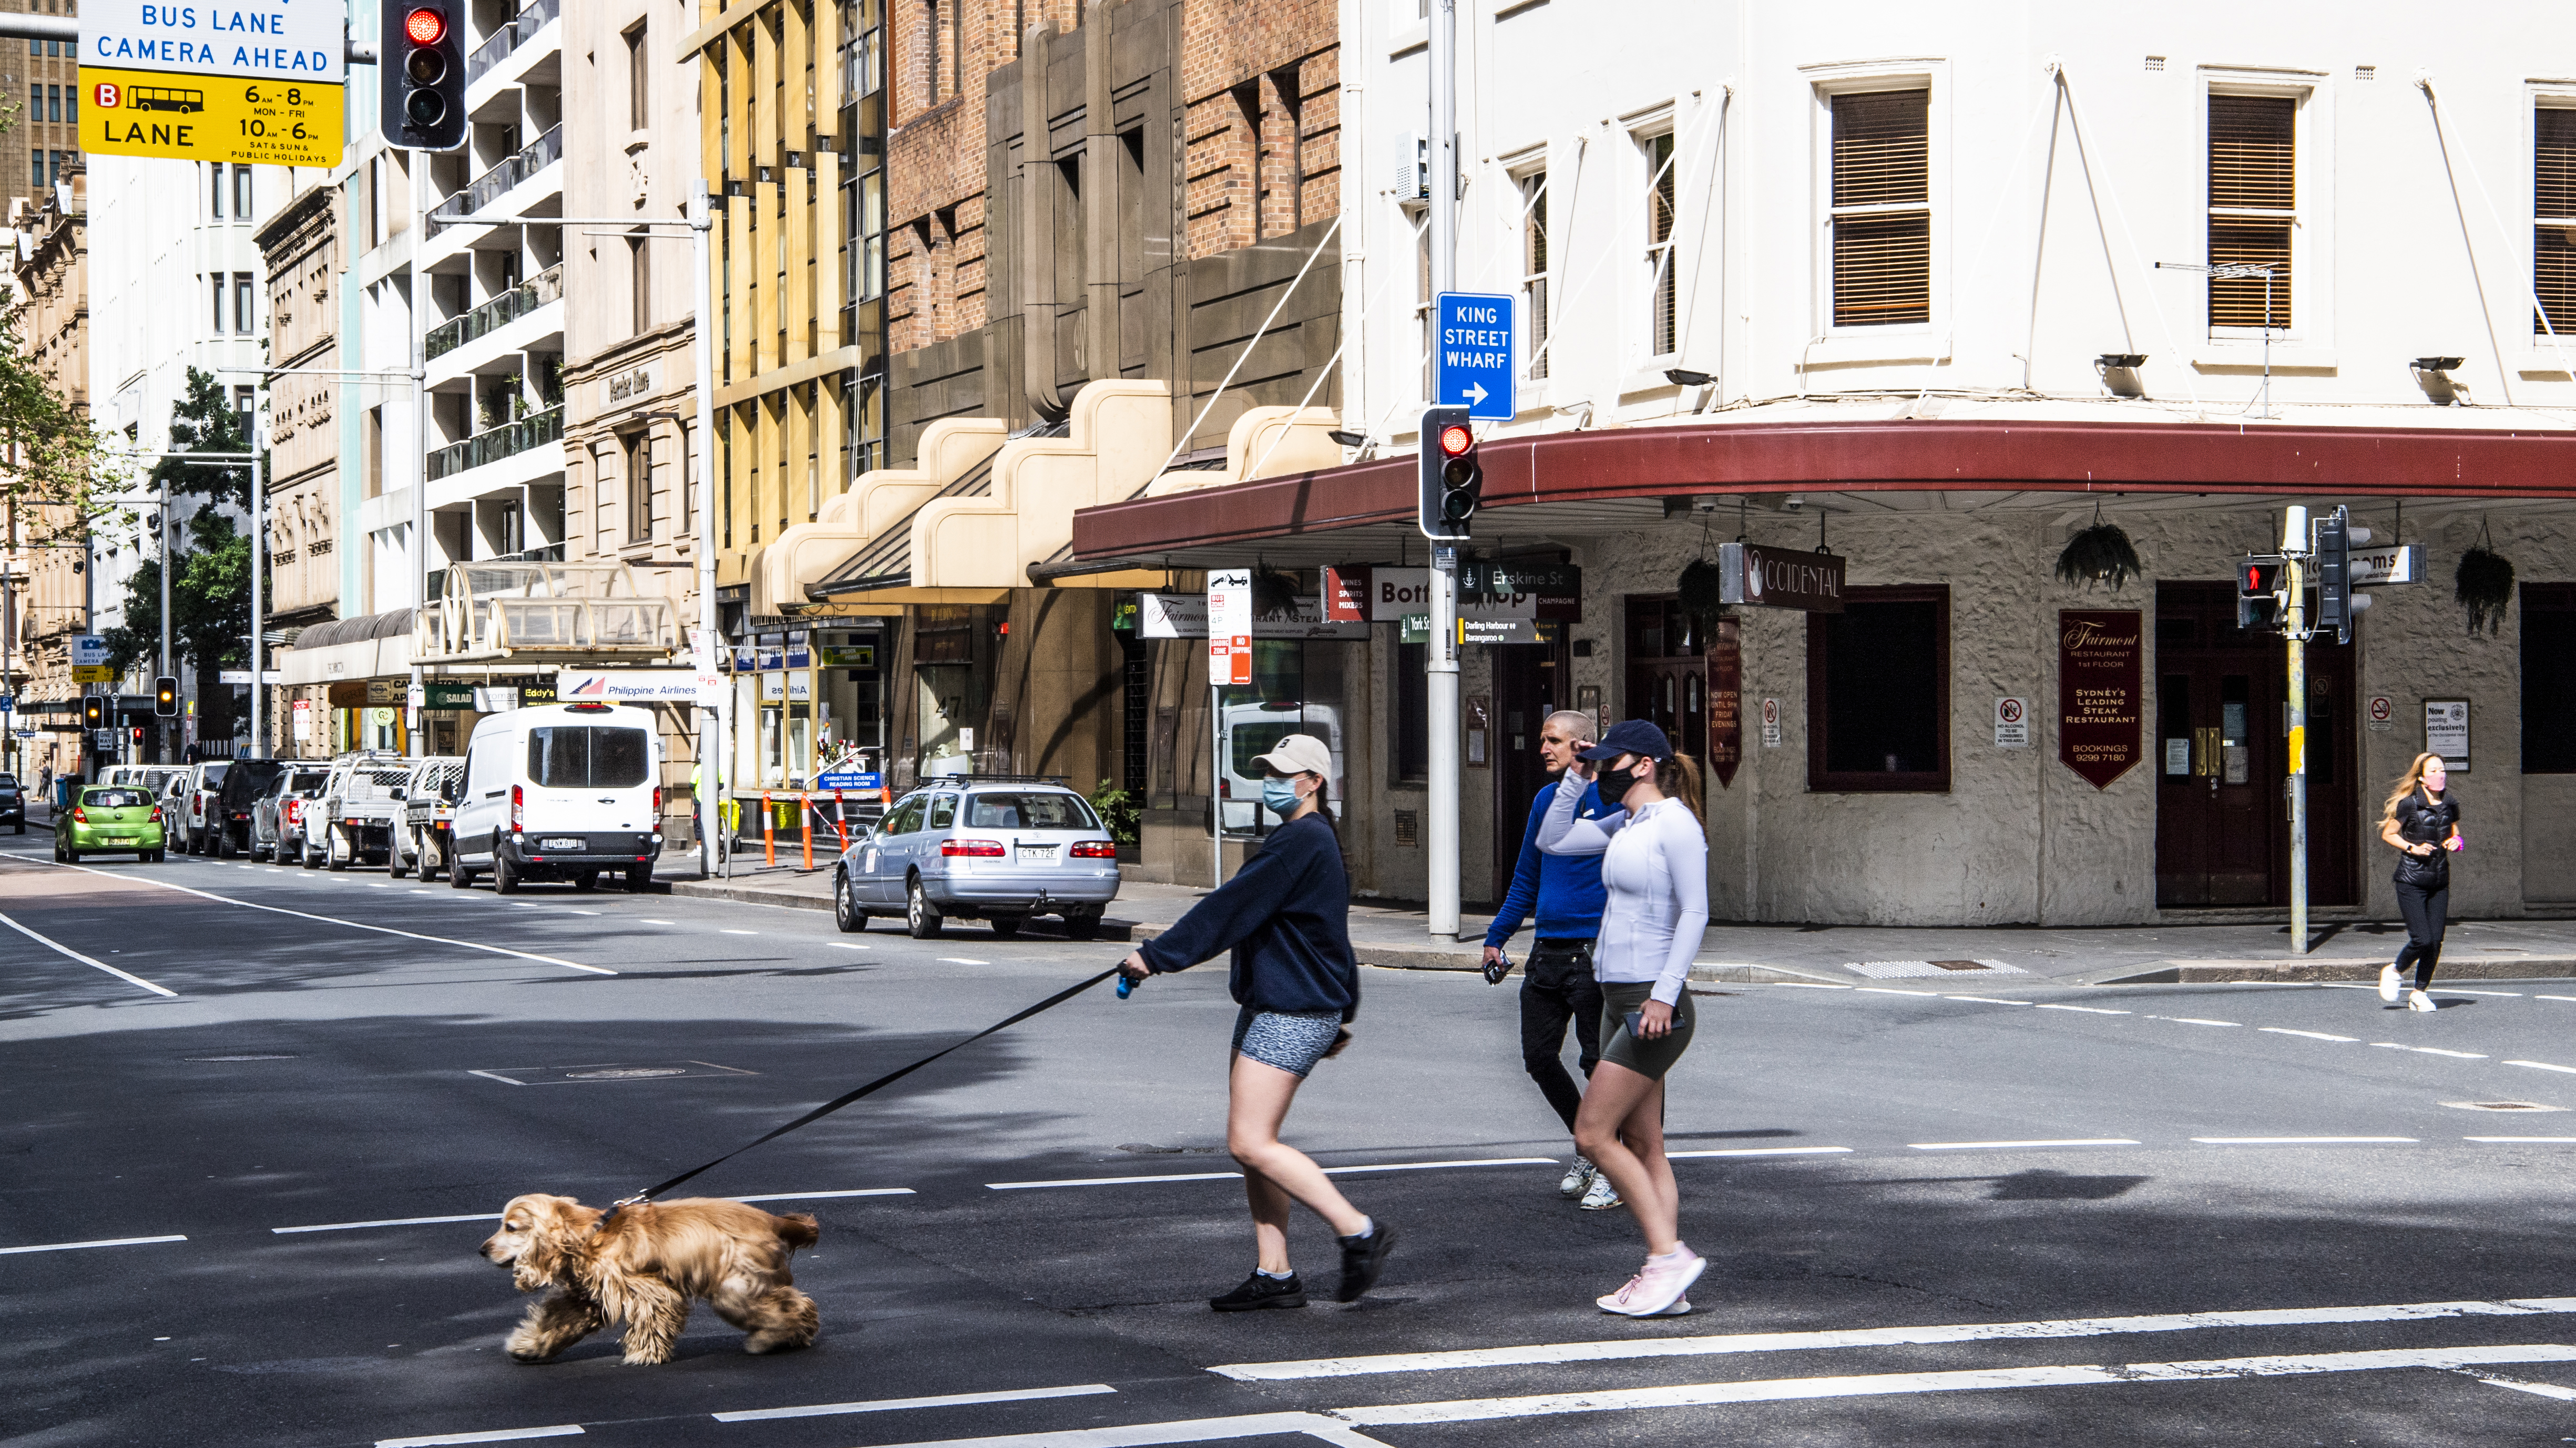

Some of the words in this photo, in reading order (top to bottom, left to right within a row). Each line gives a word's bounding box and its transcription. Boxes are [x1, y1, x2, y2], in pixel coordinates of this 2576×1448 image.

[142, 4, 196, 28] BUS
[213, 9, 284, 35] LANE
[98, 36, 214, 64] CAMERA
[233, 46, 327, 71] AHEAD
[100, 84, 116, 106] B
[254, 107, 276, 116] MON
[289, 109, 305, 118] FRI
[105, 120, 193, 147] LANE
[231, 151, 270, 159] PUBLIC
[274, 153, 326, 162] HOLIDAYS
[1456, 306, 1497, 324] KING
[1445, 328, 1509, 347] STREET
[1446, 351, 1507, 369] WHARF
[1493, 570, 1545, 584] Erskine
[1549, 571, 1563, 585] St
[1148, 598, 1208, 624] Fairmon
[1411, 617, 1423, 631] York
[1424, 616, 1430, 630] St
[1465, 621, 1485, 631] Darling
[1486, 621, 1509, 630] Harbour
[1236, 637, 1245, 645] NO
[1465, 633, 1497, 643] Barangaroo
[2063, 619, 2138, 650] Fairmont
[446, 694, 472, 703] SALAD
[525, 689, 555, 698] Eddy's
[608, 686, 654, 697] Philippine
[659, 686, 697, 694] Airlines
[2076, 687, 2126, 696] SYDNEY'S
[936, 696, 962, 718] 47
[1277, 738, 1291, 748] B
